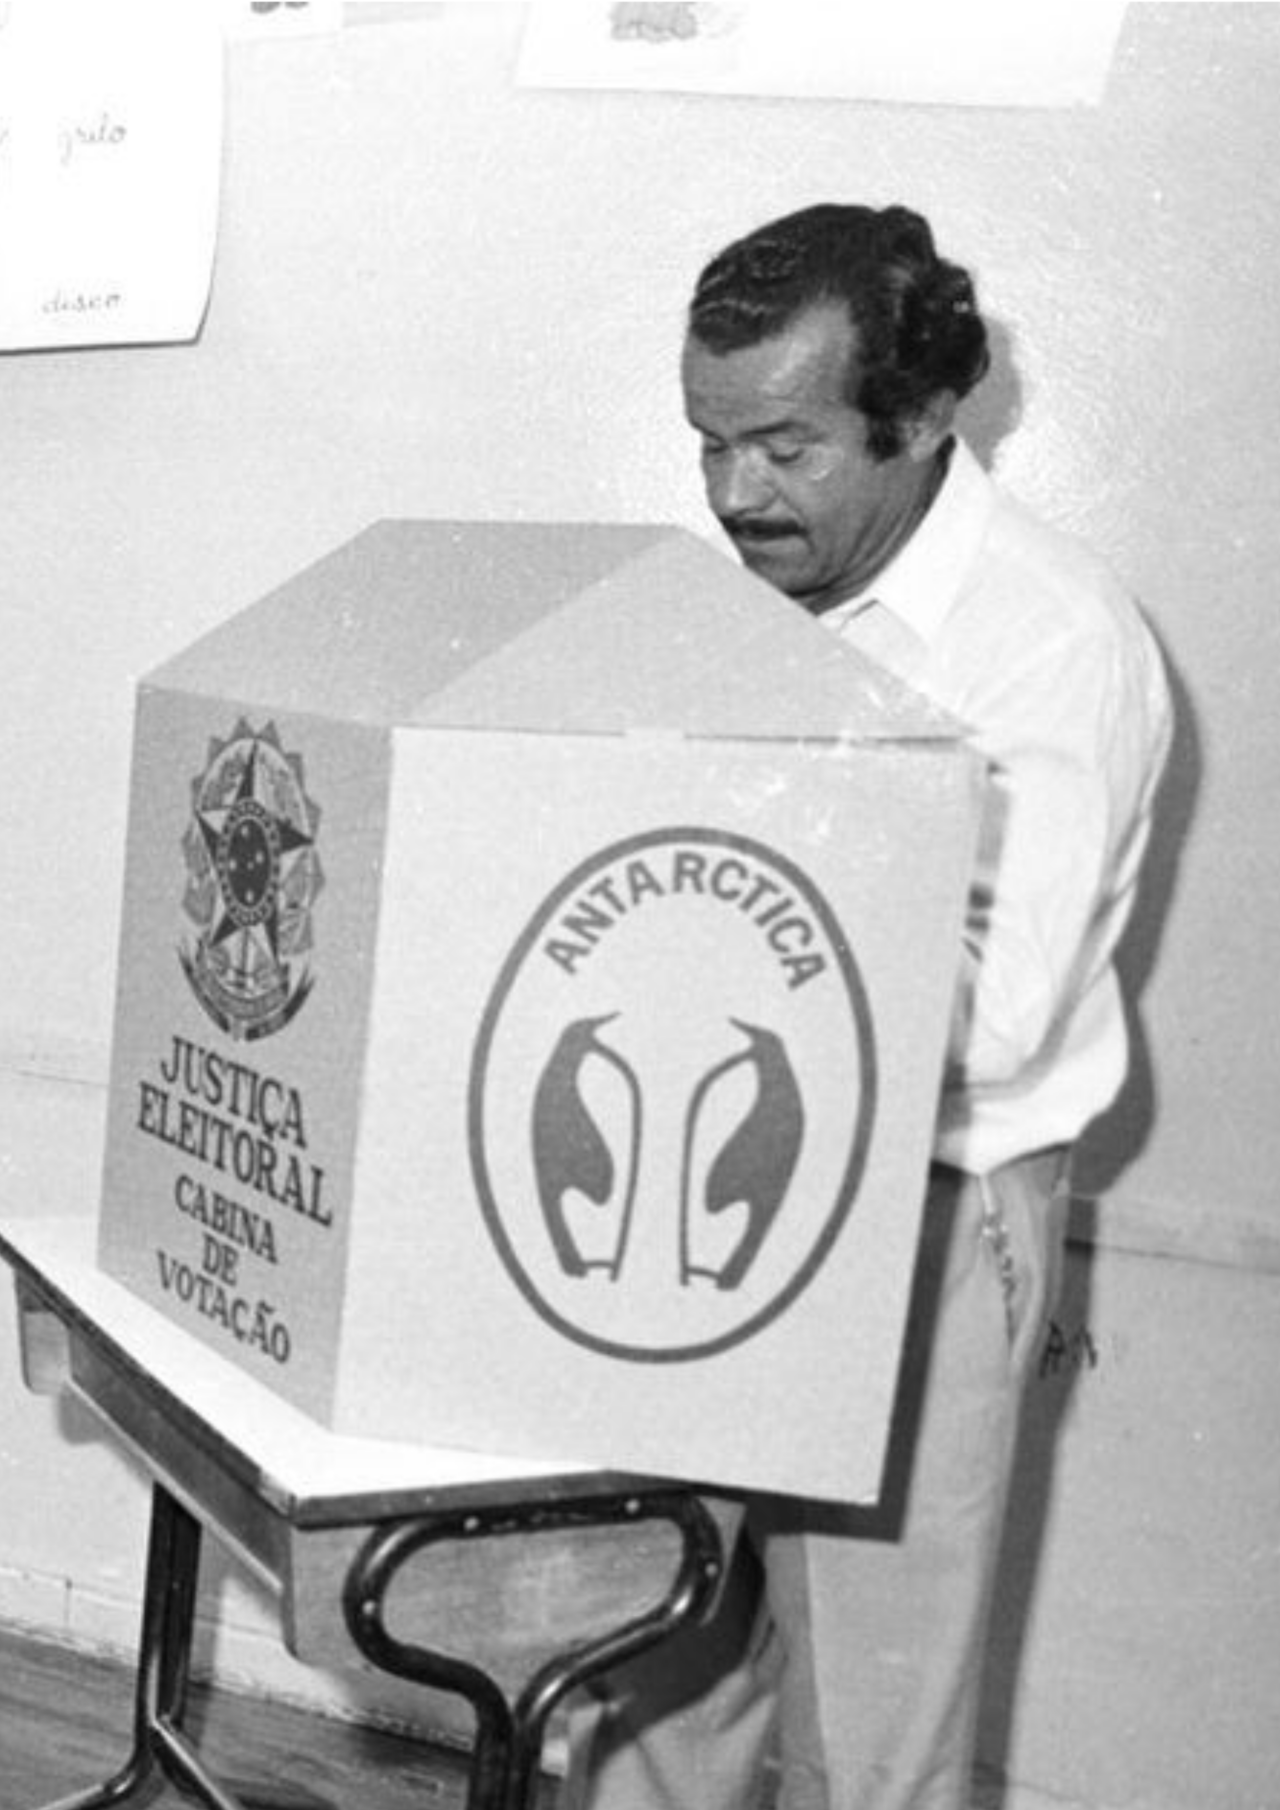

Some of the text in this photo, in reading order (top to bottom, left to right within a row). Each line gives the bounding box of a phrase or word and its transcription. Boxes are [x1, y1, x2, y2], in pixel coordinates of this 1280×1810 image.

[542, 850, 829, 991] ANTARCTICA
[161, 1035, 307, 1150] JUSTIÇA
[137, 1080, 333, 1229] ELEITORAL
[174, 1173, 279, 1265] CABINA
[201, 1231, 240, 1287] DE
[157, 1249, 291, 1364] VOTAÇÃO
